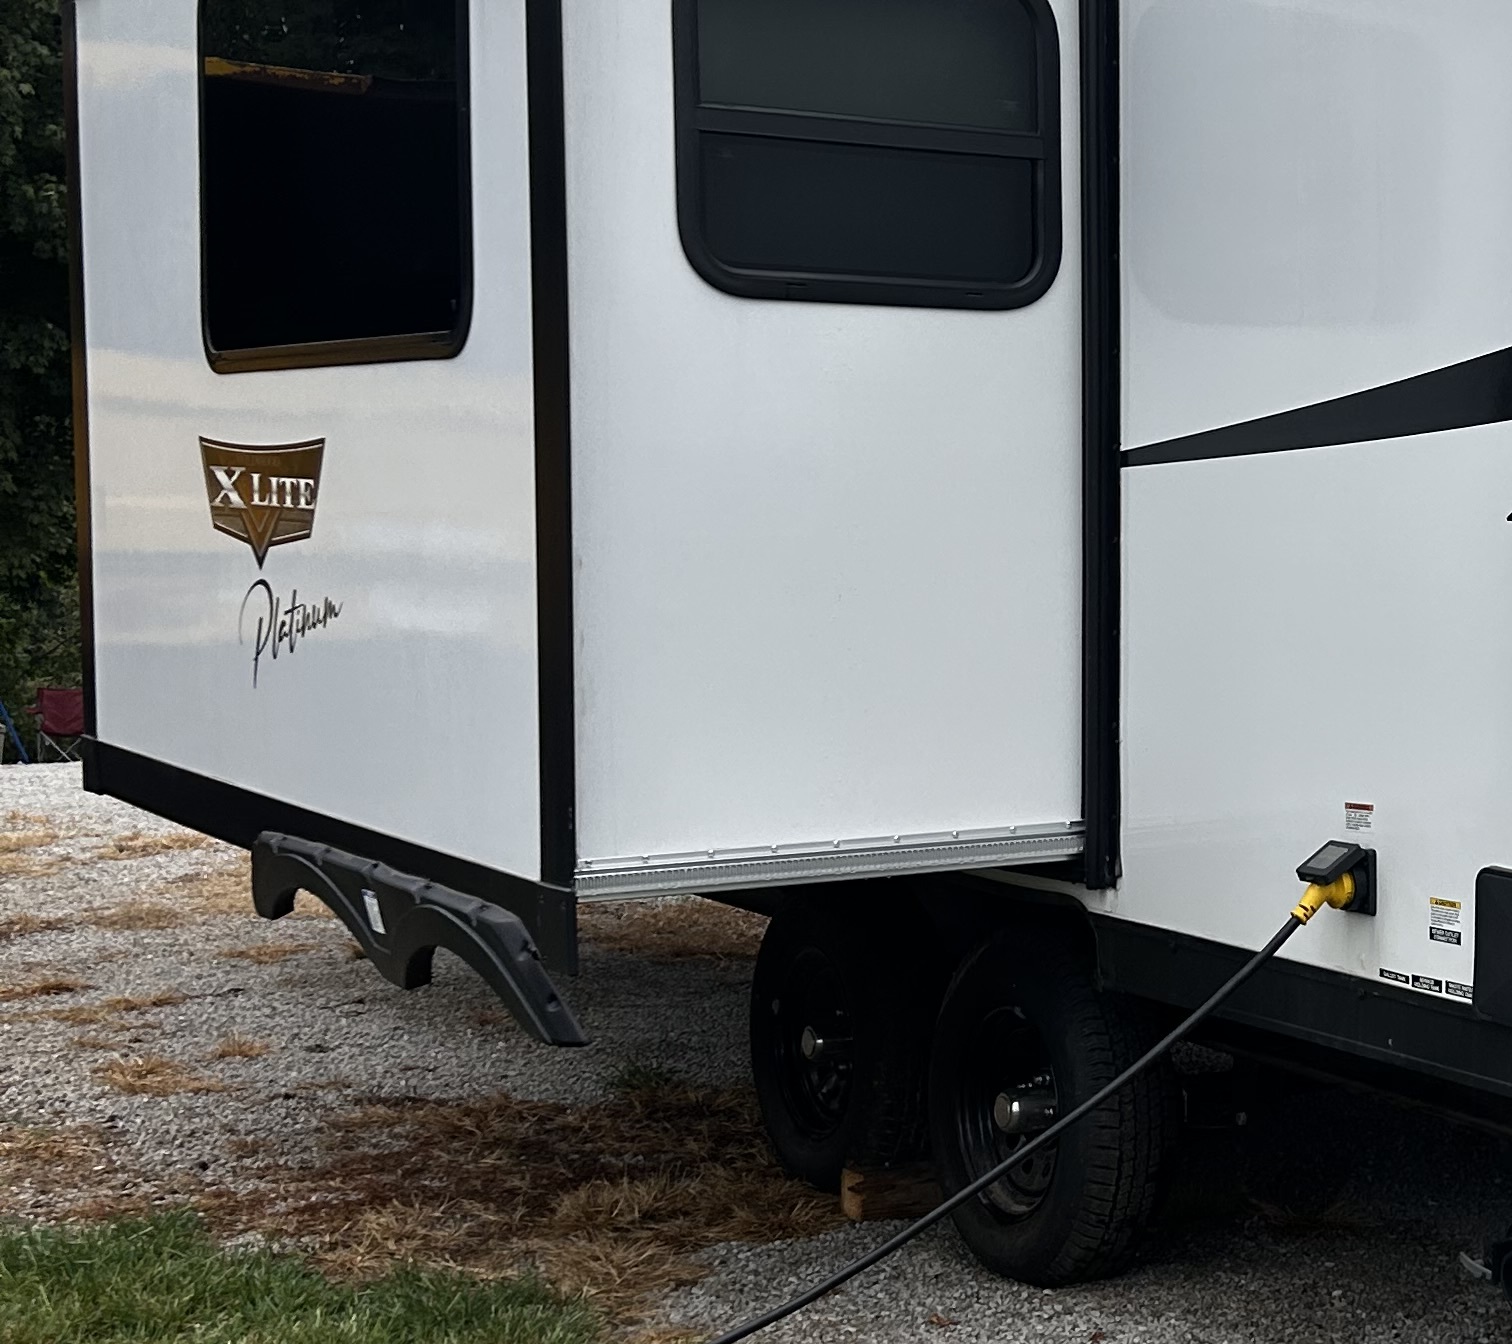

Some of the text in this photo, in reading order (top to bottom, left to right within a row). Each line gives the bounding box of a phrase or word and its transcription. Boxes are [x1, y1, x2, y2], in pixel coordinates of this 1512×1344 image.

[209, 465, 315, 509] X LITE
[239, 578, 343, 689] Platinum
